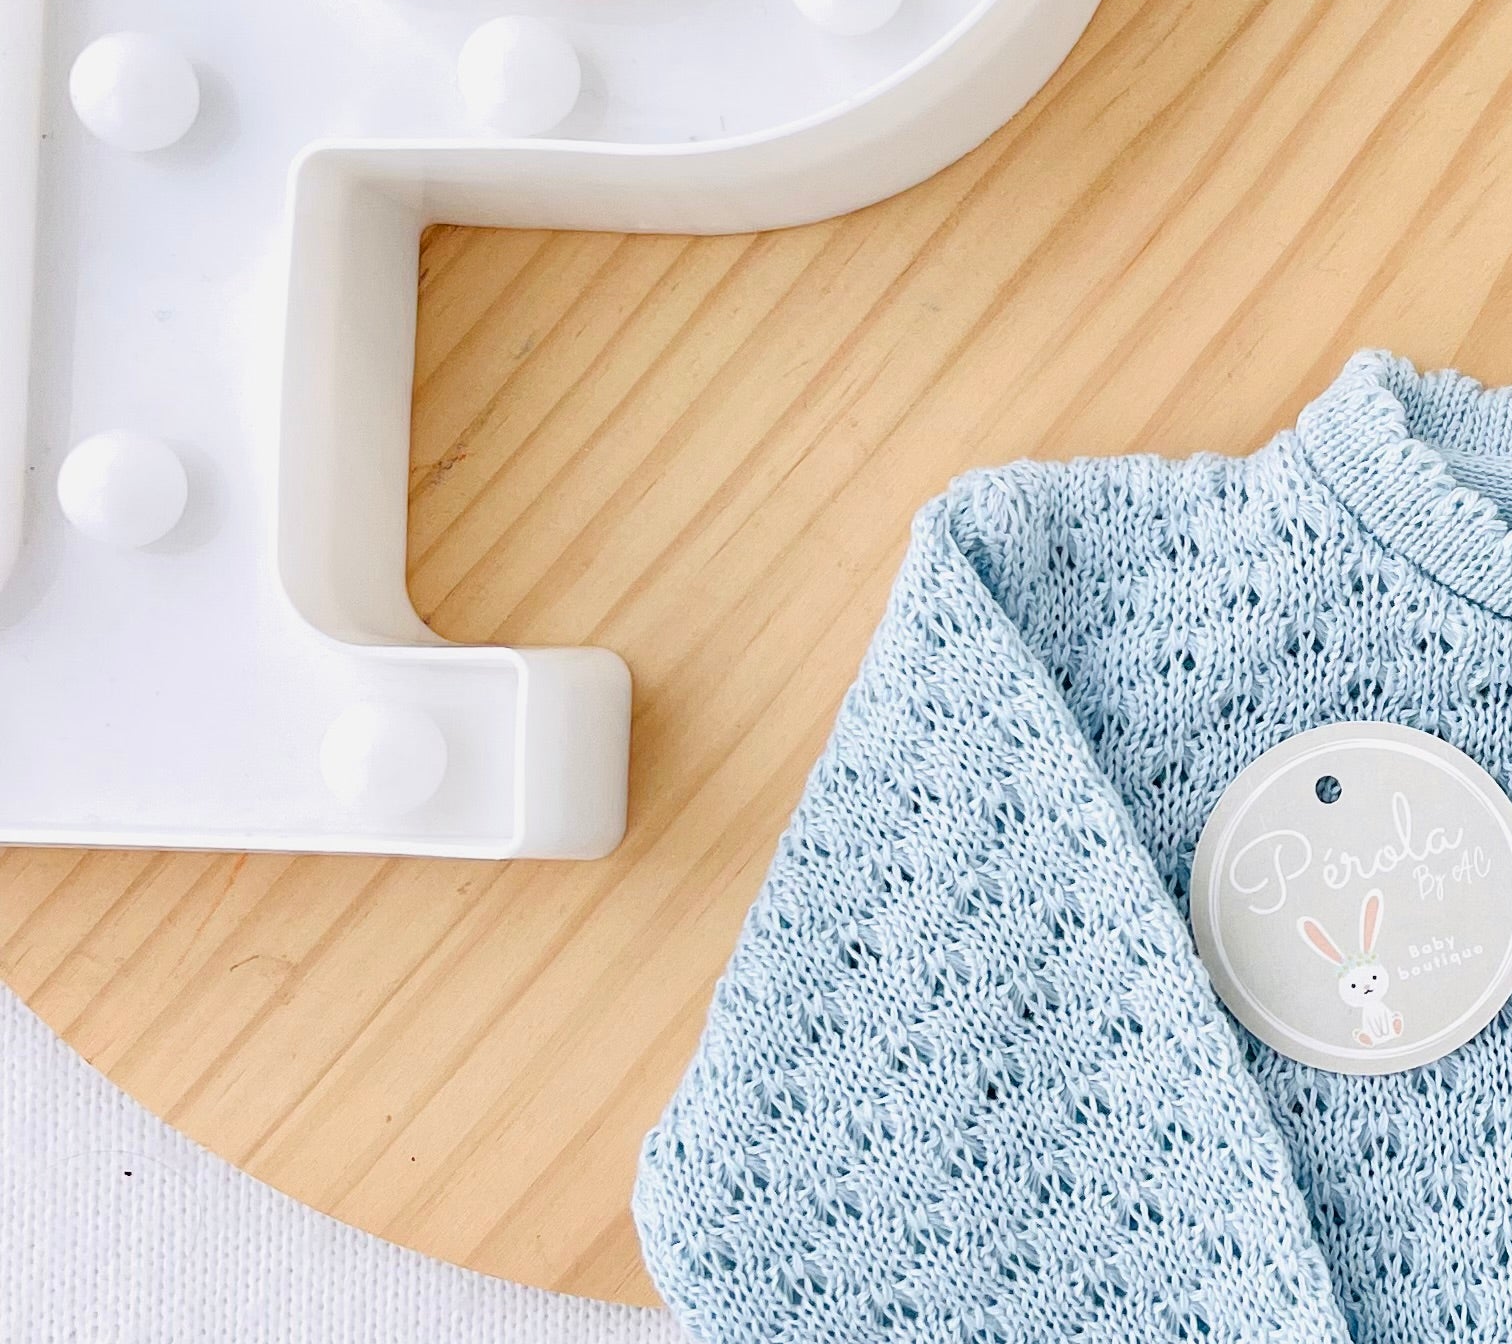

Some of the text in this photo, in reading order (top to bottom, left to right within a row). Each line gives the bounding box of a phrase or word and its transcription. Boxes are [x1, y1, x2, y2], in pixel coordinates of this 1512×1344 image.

[1230, 791, 1463, 914] Pérola
[1413, 846, 1491, 901] By AC
[1397, 944, 1483, 980] boutique
[1408, 934, 1456, 958] Baby
